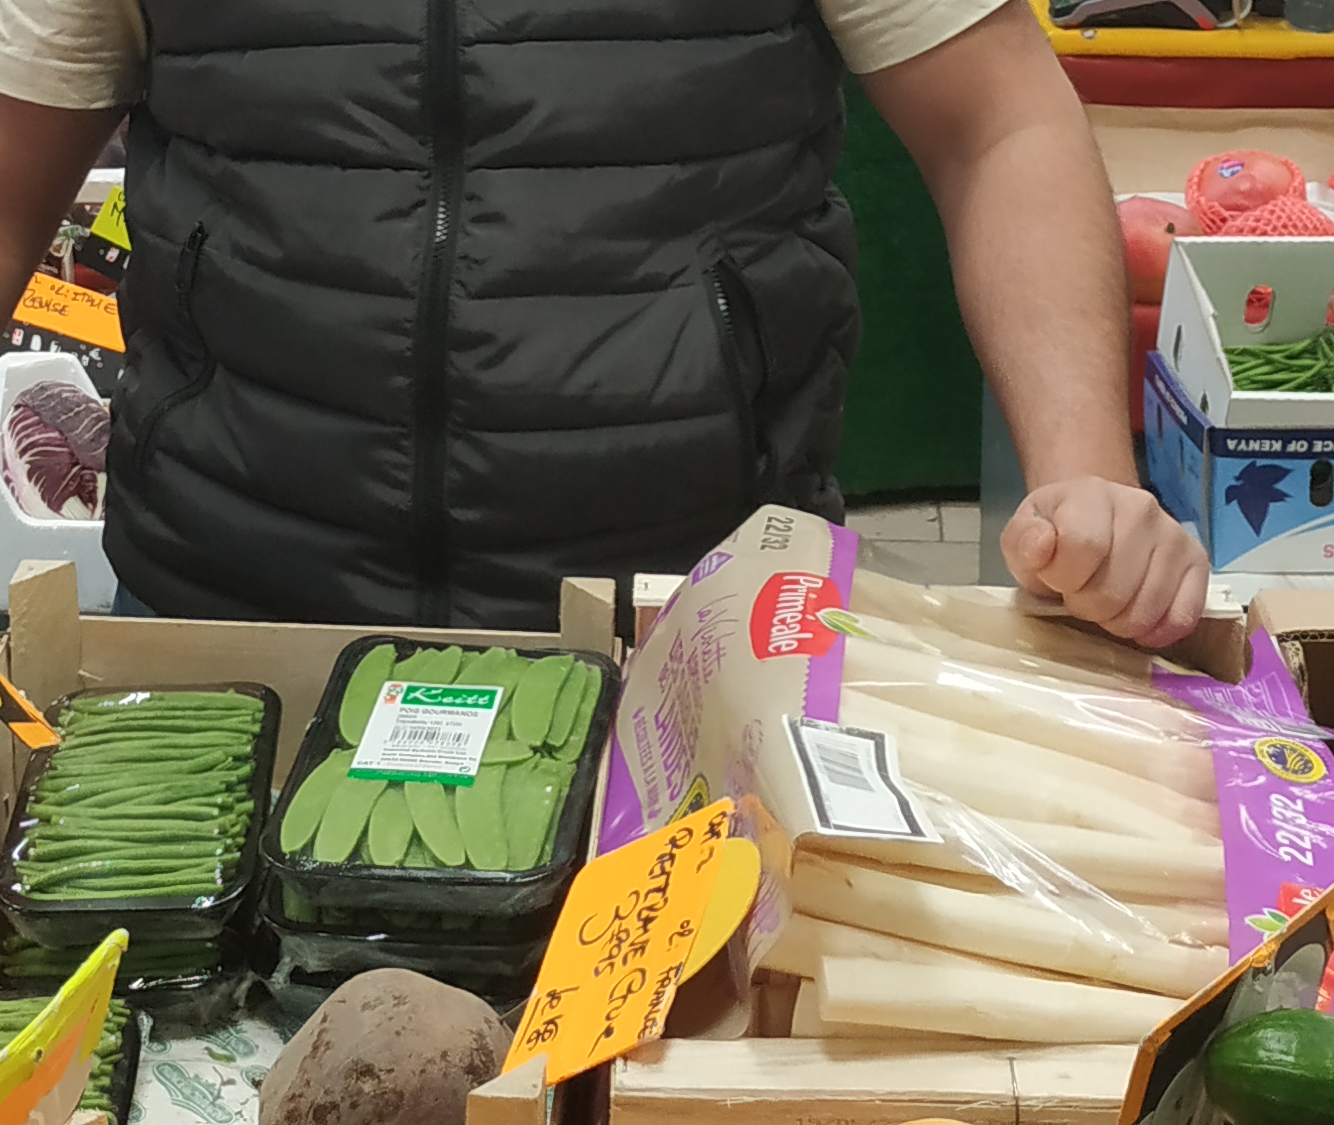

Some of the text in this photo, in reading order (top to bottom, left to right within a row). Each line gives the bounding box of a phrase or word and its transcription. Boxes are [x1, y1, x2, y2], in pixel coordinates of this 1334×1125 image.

[1226, 437, 1282, 451] KENYA
[1285, 438, 1308, 452] OF
[768, 575, 824, 654] Priméale
[1269, 793, 1315, 867] 22/32
